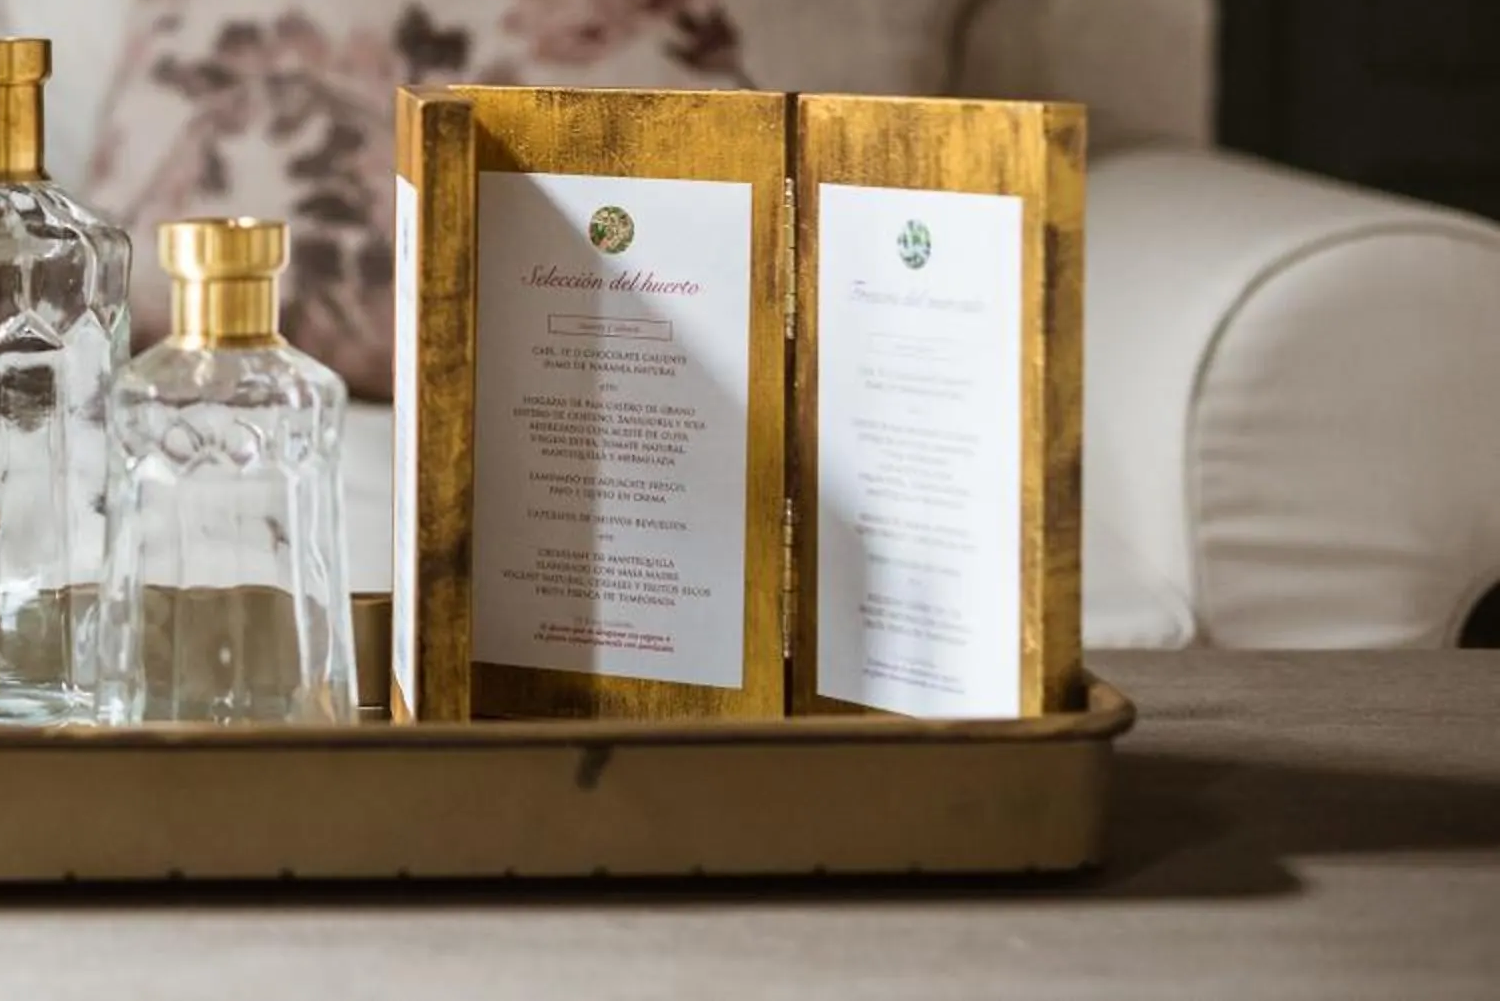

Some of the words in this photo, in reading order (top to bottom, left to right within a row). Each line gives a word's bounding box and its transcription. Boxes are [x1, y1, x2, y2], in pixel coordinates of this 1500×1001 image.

[521, 265, 603, 292] Selección
[609, 270, 640, 292] del
[640, 272, 700, 296] huerto
